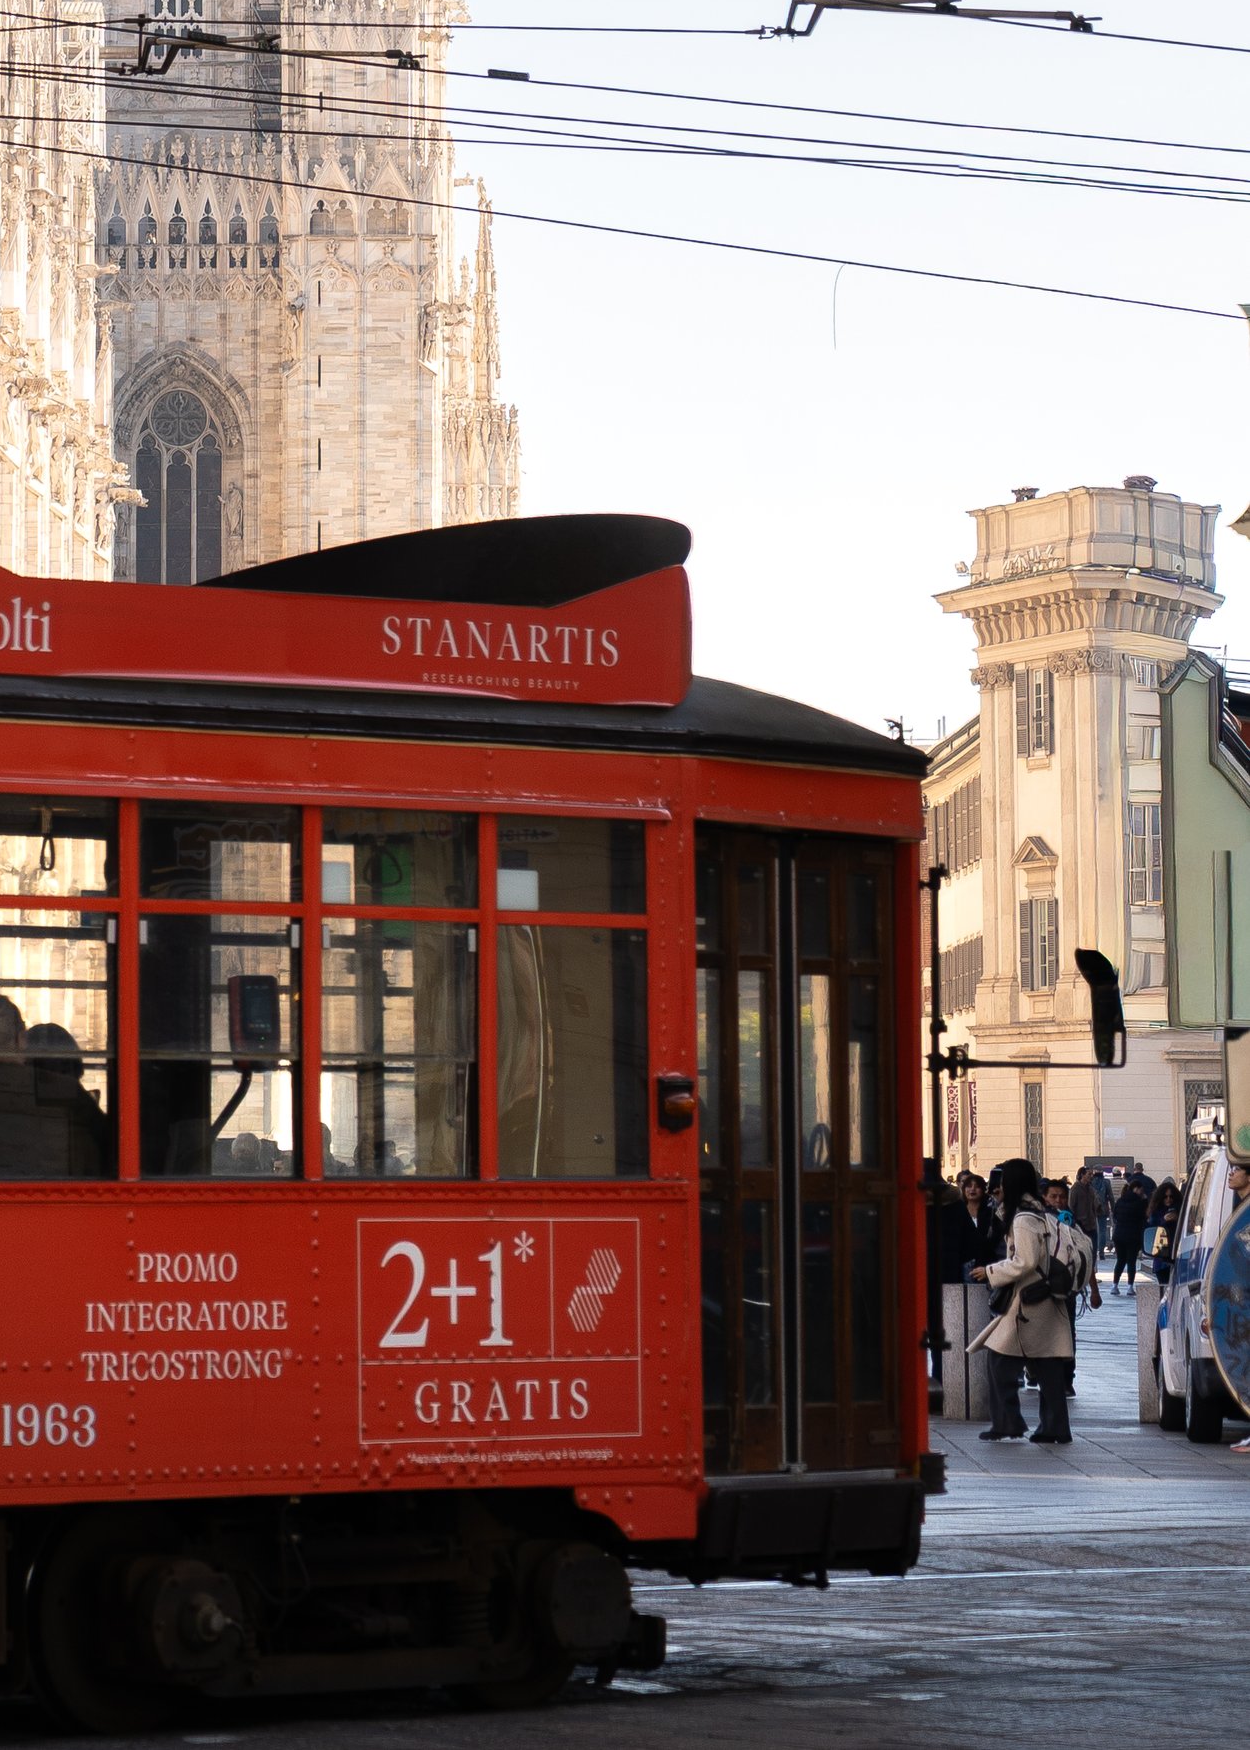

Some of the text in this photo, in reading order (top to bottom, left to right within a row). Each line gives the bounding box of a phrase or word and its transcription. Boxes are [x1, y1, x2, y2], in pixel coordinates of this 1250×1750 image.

[382, 616, 619, 667] STANARTIS
[422, 672, 580, 690] RESEARCHING BEAUTY
[137, 1252, 238, 1283] PROMO
[85, 1300, 288, 1333] INTEGRATORE
[414, 1378, 589, 1423] GRATIS
[1, 1402, 97, 1448] 1963
